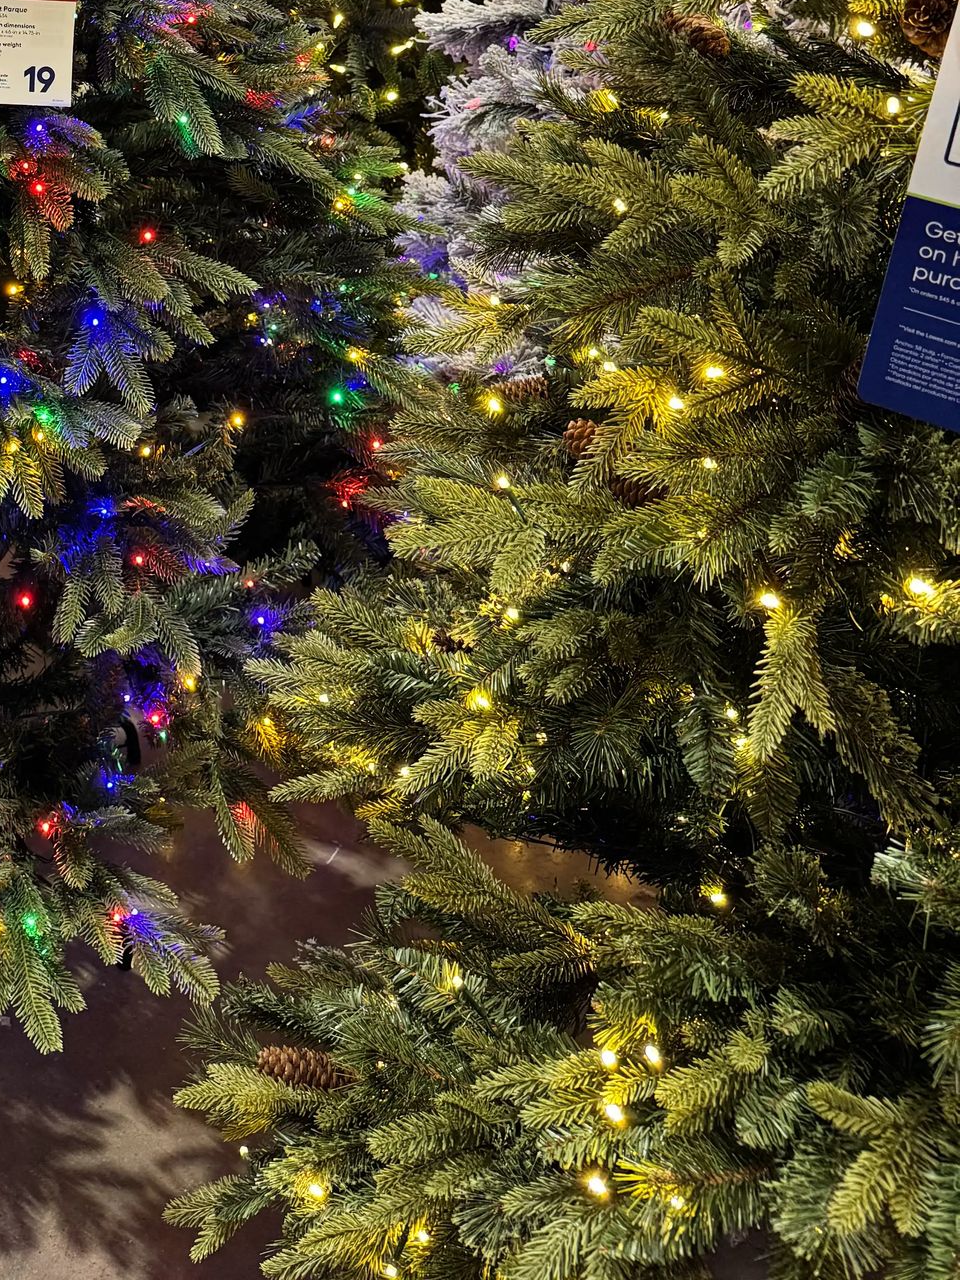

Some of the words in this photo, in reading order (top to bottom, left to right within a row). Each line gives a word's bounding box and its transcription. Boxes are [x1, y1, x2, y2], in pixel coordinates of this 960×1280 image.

[3, 5, 28, 13] Parque
[2, 41, 22, 49] weight
[23, 65, 56, 93] 19
[919, 246, 946, 264] on
